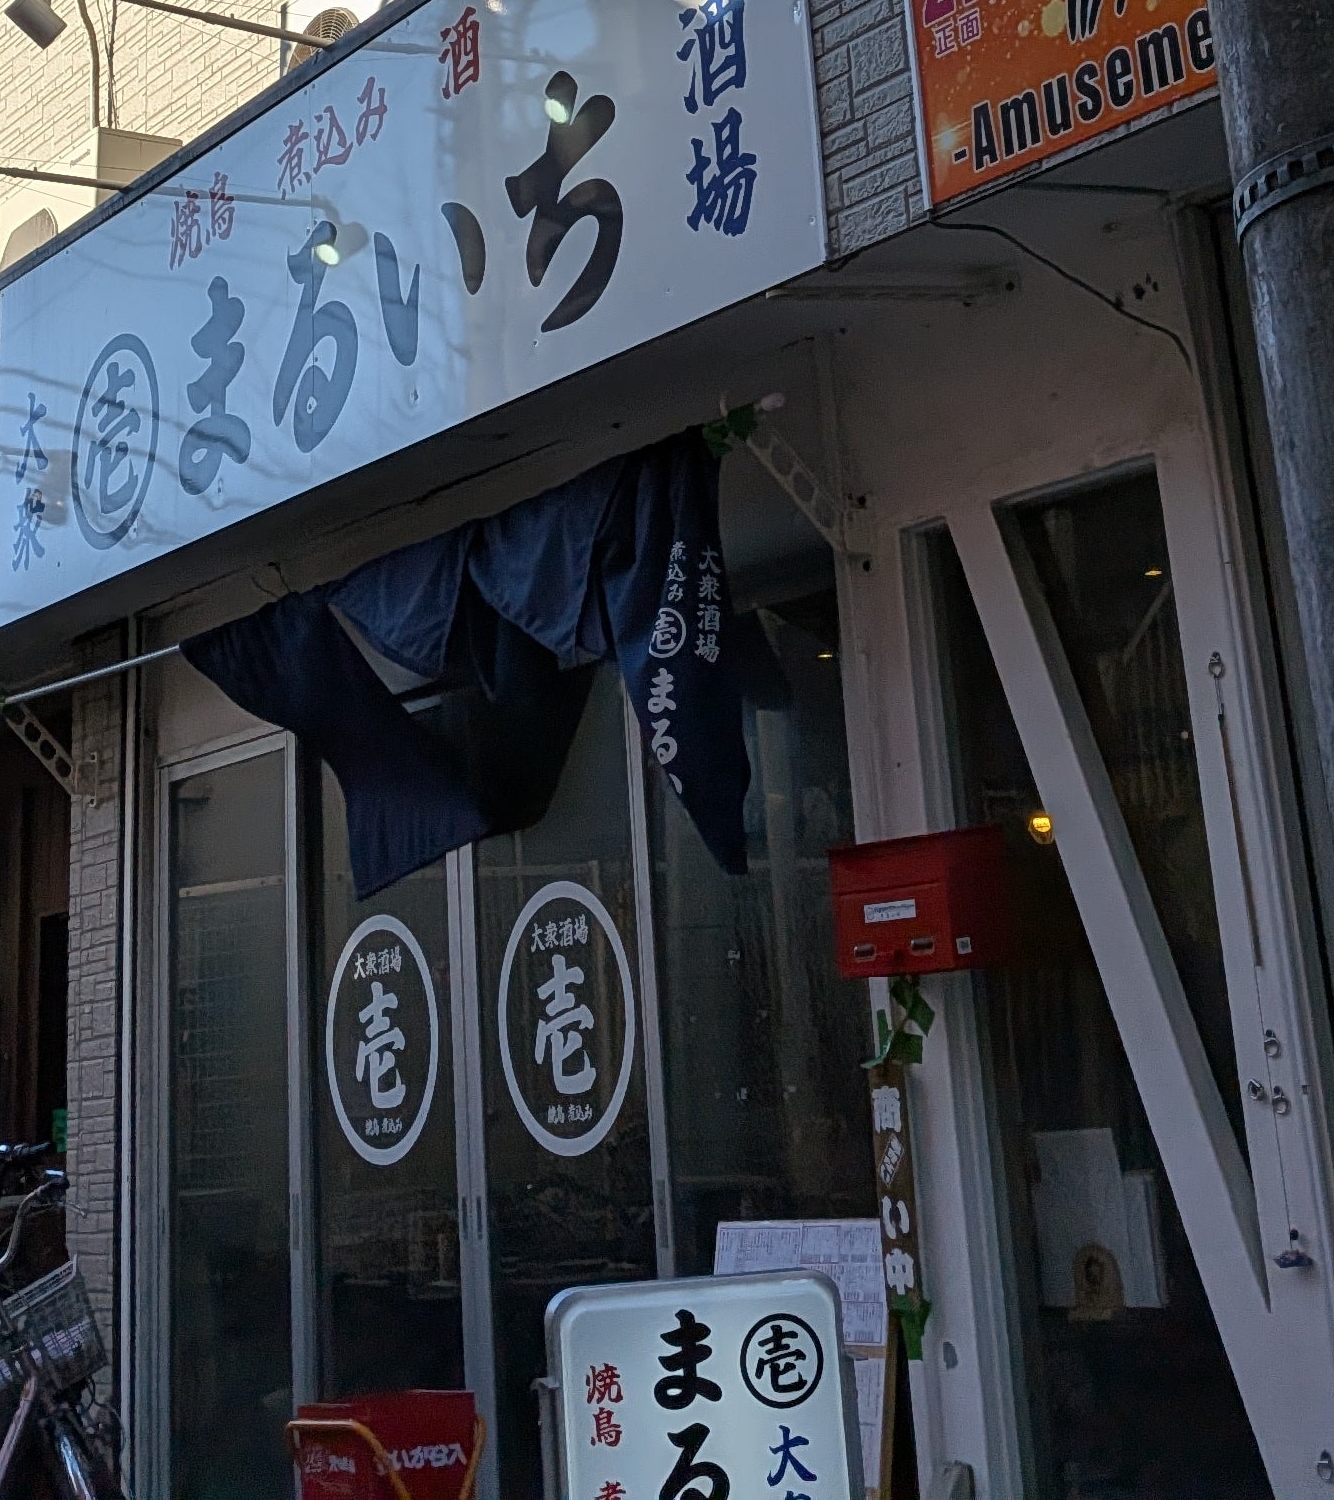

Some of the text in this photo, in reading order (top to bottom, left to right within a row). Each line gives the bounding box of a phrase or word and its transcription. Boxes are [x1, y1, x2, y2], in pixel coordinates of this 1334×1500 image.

[935, 10, 981, 57] 正面
[169, 5, 481, 271] 焼鳥 煮込み 酒
[178, 70, 625, 497] まるいち
[12, 391, 49, 572] 大衆
[667, 540, 687, 602] 煮込み
[693, 545, 722, 664] 大衆酒場
[353, 945, 402, 980] 大衆酒場
[531, 914, 589, 953] 大衆酒場
[356, 981, 407, 1109] 壱
[535, 954, 597, 1094] 壱
[585, 1362, 624, 1447] 焼鳥
[755, 1325, 807, 1393] 壱
